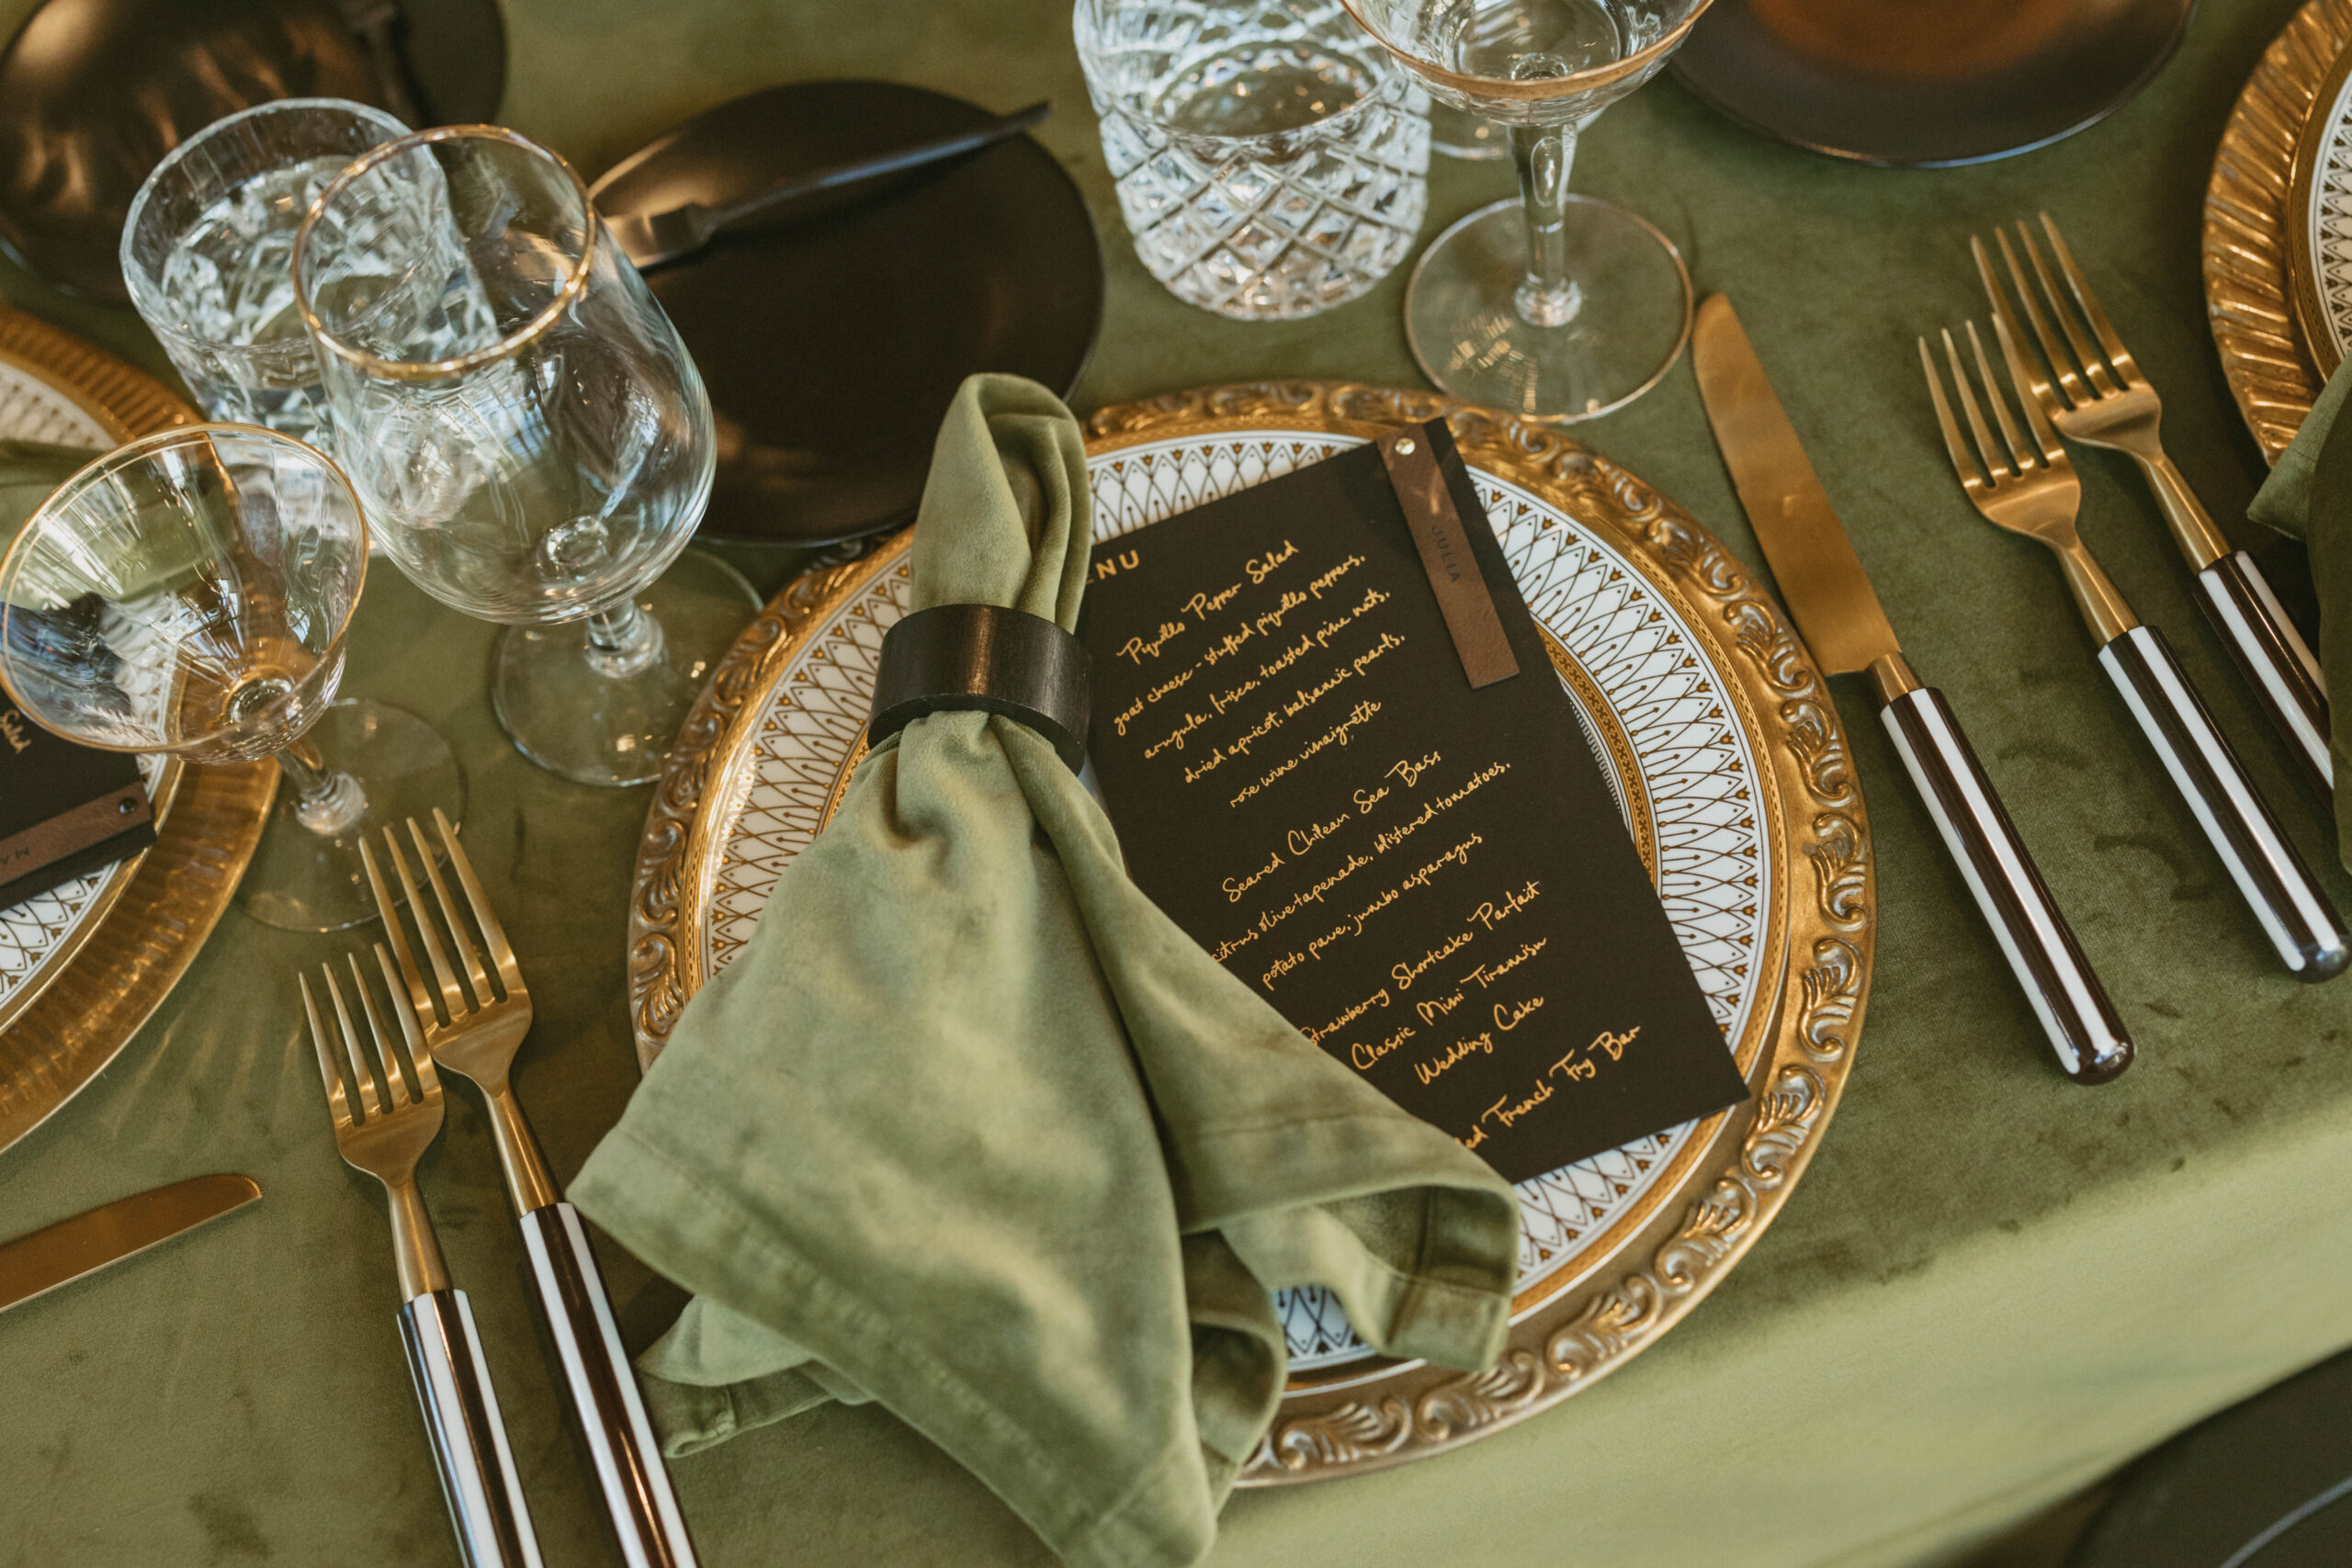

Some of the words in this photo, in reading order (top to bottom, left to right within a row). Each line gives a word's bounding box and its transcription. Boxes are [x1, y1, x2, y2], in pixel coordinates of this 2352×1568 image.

[1115, 621, 1186, 665] Piquillo
[1180, 582, 1242, 621] Pepper
[1245, 539, 1300, 585] Salad
[1430, 525, 1461, 583] JULIA
[1114, 697, 1145, 737] goat
[1147, 669, 1193, 704] cheese
[1204, 621, 1256, 666] stuffed
[1256, 591, 1307, 637] piquillo
[1260, 633, 1317, 679] toasted
[1316, 616, 1352, 649] pine
[1184, 748, 1227, 784] dried
[1283, 668, 1353, 717] balsamic
[1229, 784, 1261, 808] rose
[1260, 758, 1299, 787] wine
[1299, 699, 1382, 761] vinaigrette
[1211, 928, 1260, 963] citrus
[1258, 905, 1295, 932] olive
[1374, 802, 1439, 854] blistered
[1222, 852, 1286, 903] Seared
[1287, 813, 1351, 856] Chilean
[1352, 785, 1390, 815] Sea
[1385, 750, 1442, 792] Bass
[1261, 951, 1306, 992] potato
[1347, 888, 1399, 937] jumbo
[1402, 832, 1483, 891] asparagus
[1390, 931, 1474, 991] Shortcake
[1465, 881, 1541, 931] Parfait
[1351, 1026, 1417, 1080] Classic
[1416, 987, 1464, 1027] Mini
[1459, 937, 1547, 989] Tiramisu
[1413, 1032, 1494, 1086] Wedding
[1493, 996, 1544, 1032] Cake
[1480, 1078, 1555, 1128] French
[1548, 1048, 1597, 1082] Fry
[1587, 1025, 1641, 1062] Bar
